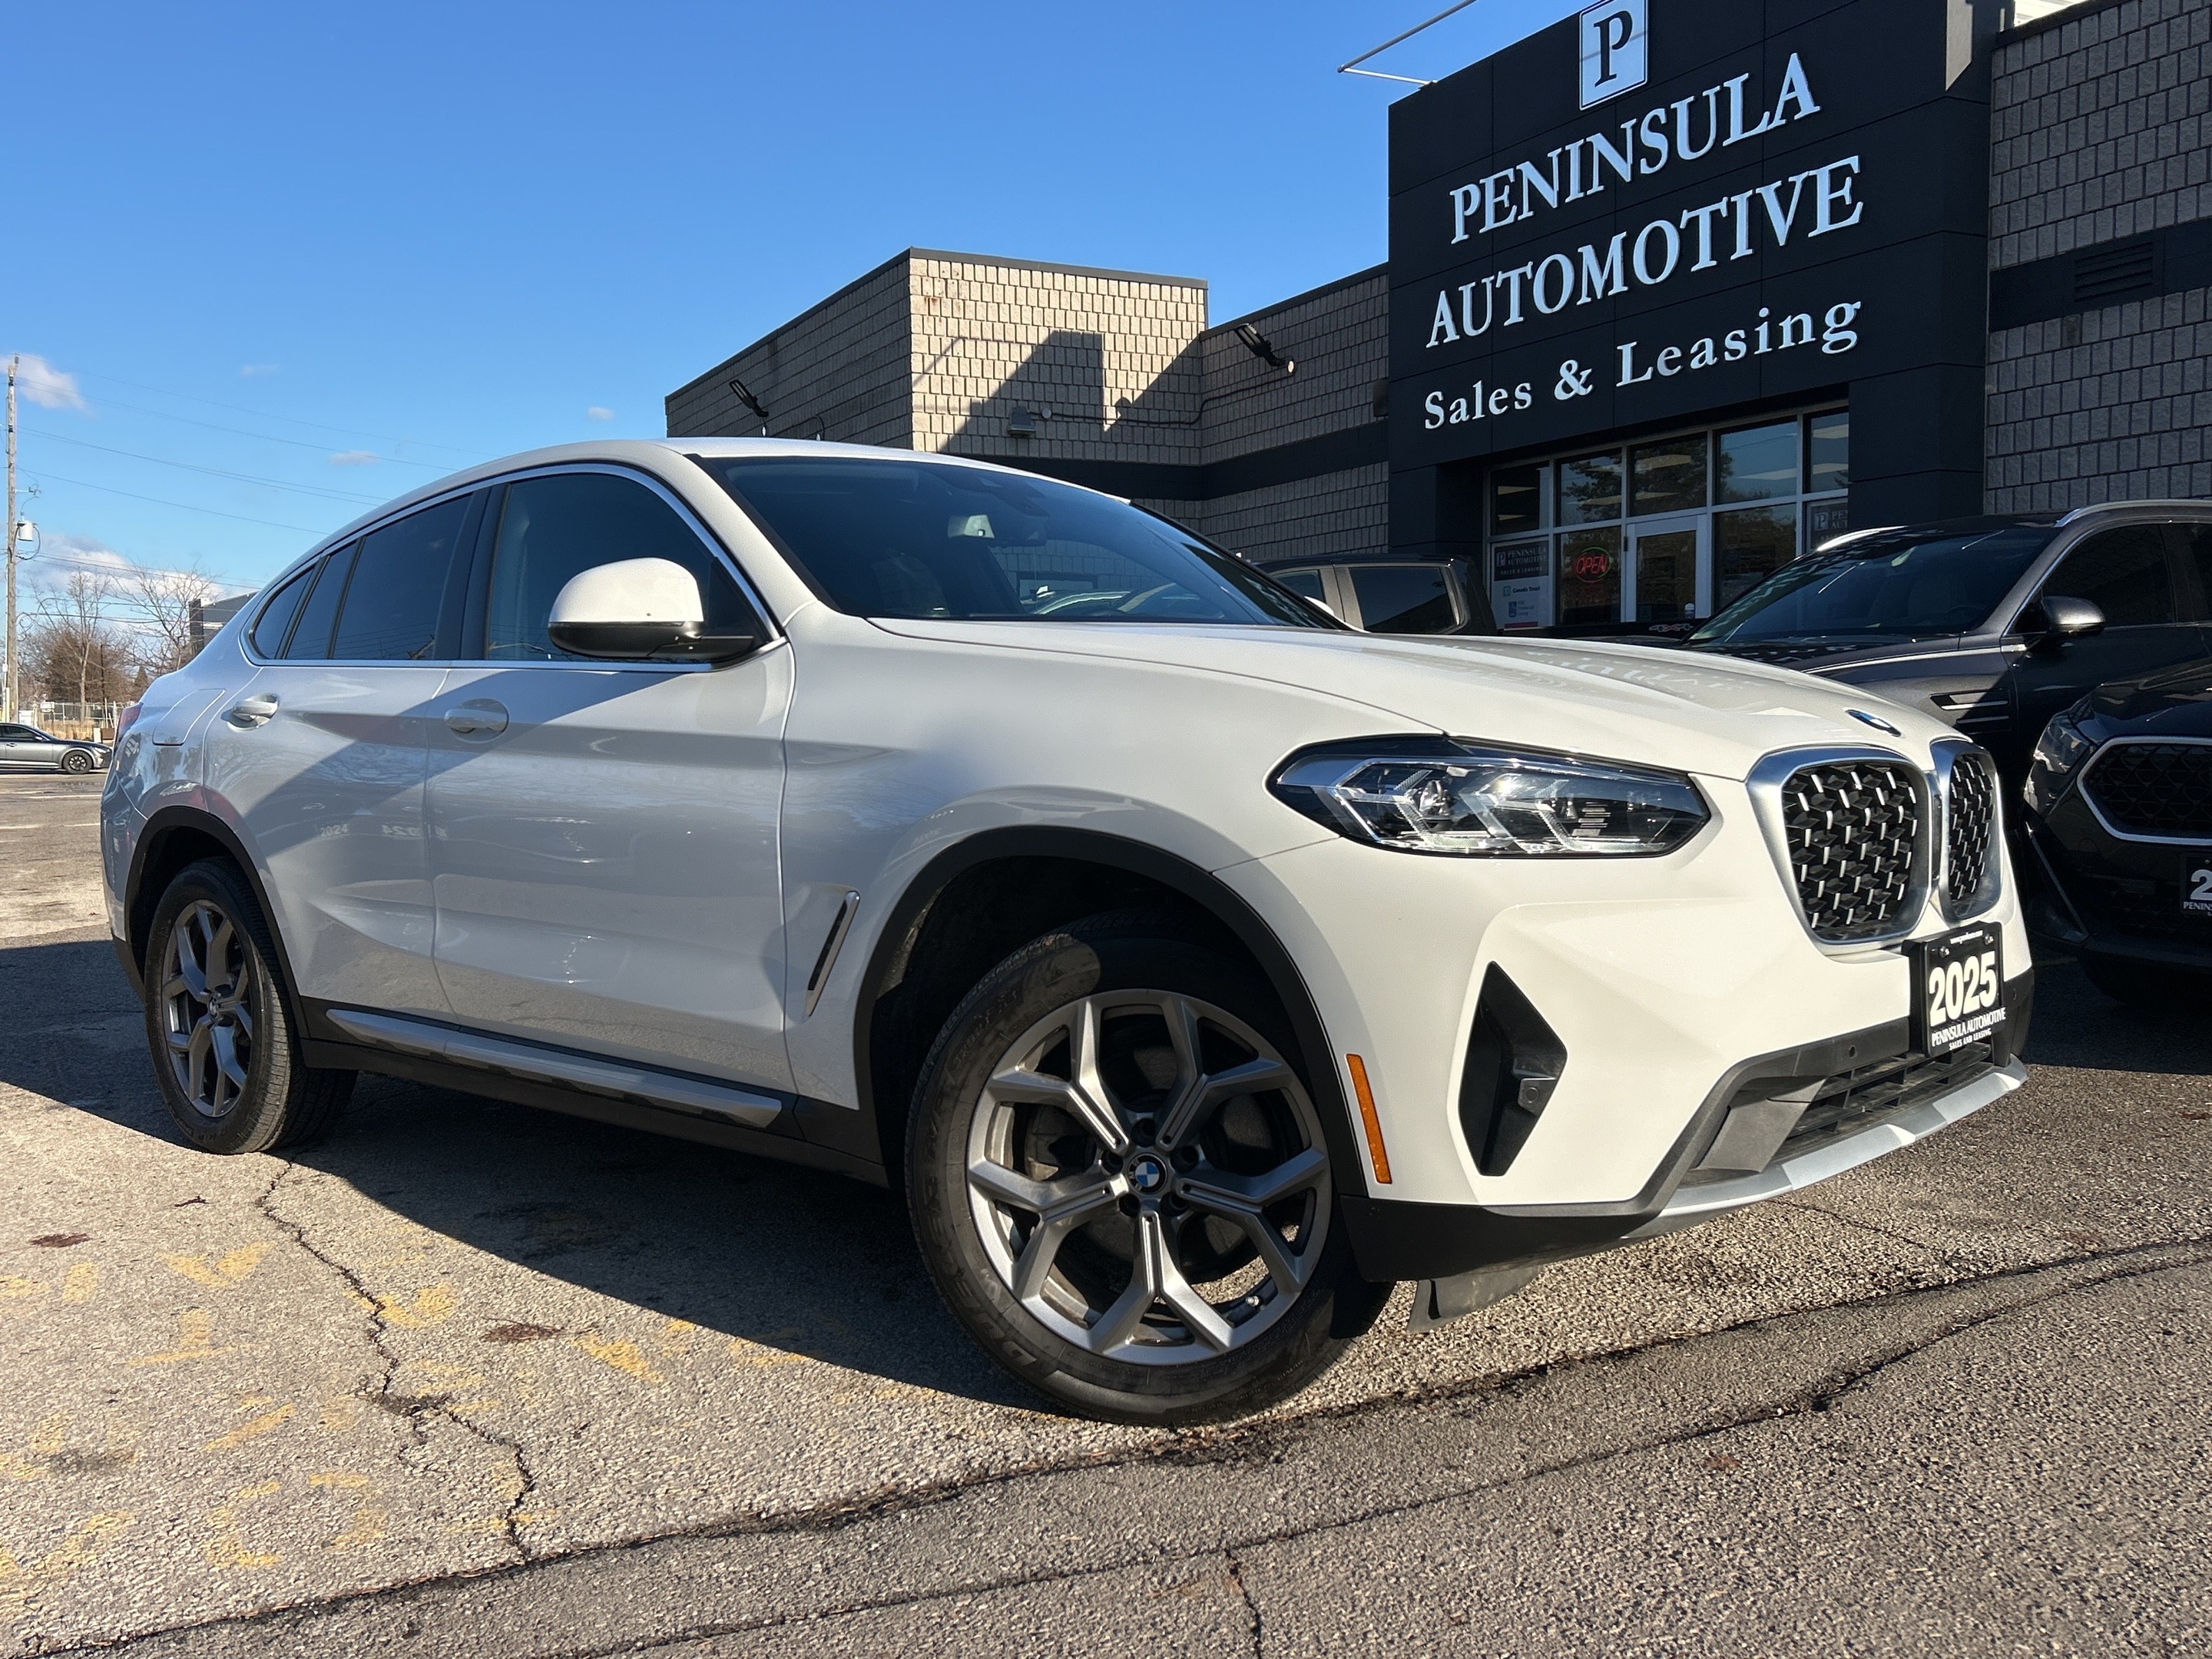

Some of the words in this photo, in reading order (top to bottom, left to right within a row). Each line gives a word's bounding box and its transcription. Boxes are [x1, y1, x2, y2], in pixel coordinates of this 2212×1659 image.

[1593, 10, 1634, 88] P
[1449, 52, 1821, 245] PENINSULA
[1425, 154, 1864, 350] AUTOMOTIVE
[1423, 379, 1533, 429] Sales
[1553, 358, 1594, 401] &
[1616, 300, 1863, 387] Leasing
[1507, 546, 1547, 558] PENINSULA
[1508, 555, 1547, 565] AUTOMOTIVE
[1575, 553, 1608, 575] OPEN
[2190, 869, 2212, 901] 2
[1929, 951, 1997, 1027] 2025
[1966, 1007, 2006, 1033] AUTOMOTIVE
[1931, 1022, 1967, 1048] PENINSULA
[1949, 1038, 1963, 1051] SALES
[1963, 1034, 1973, 1045] AND
[1973, 1028, 1992, 1041] LEASING
